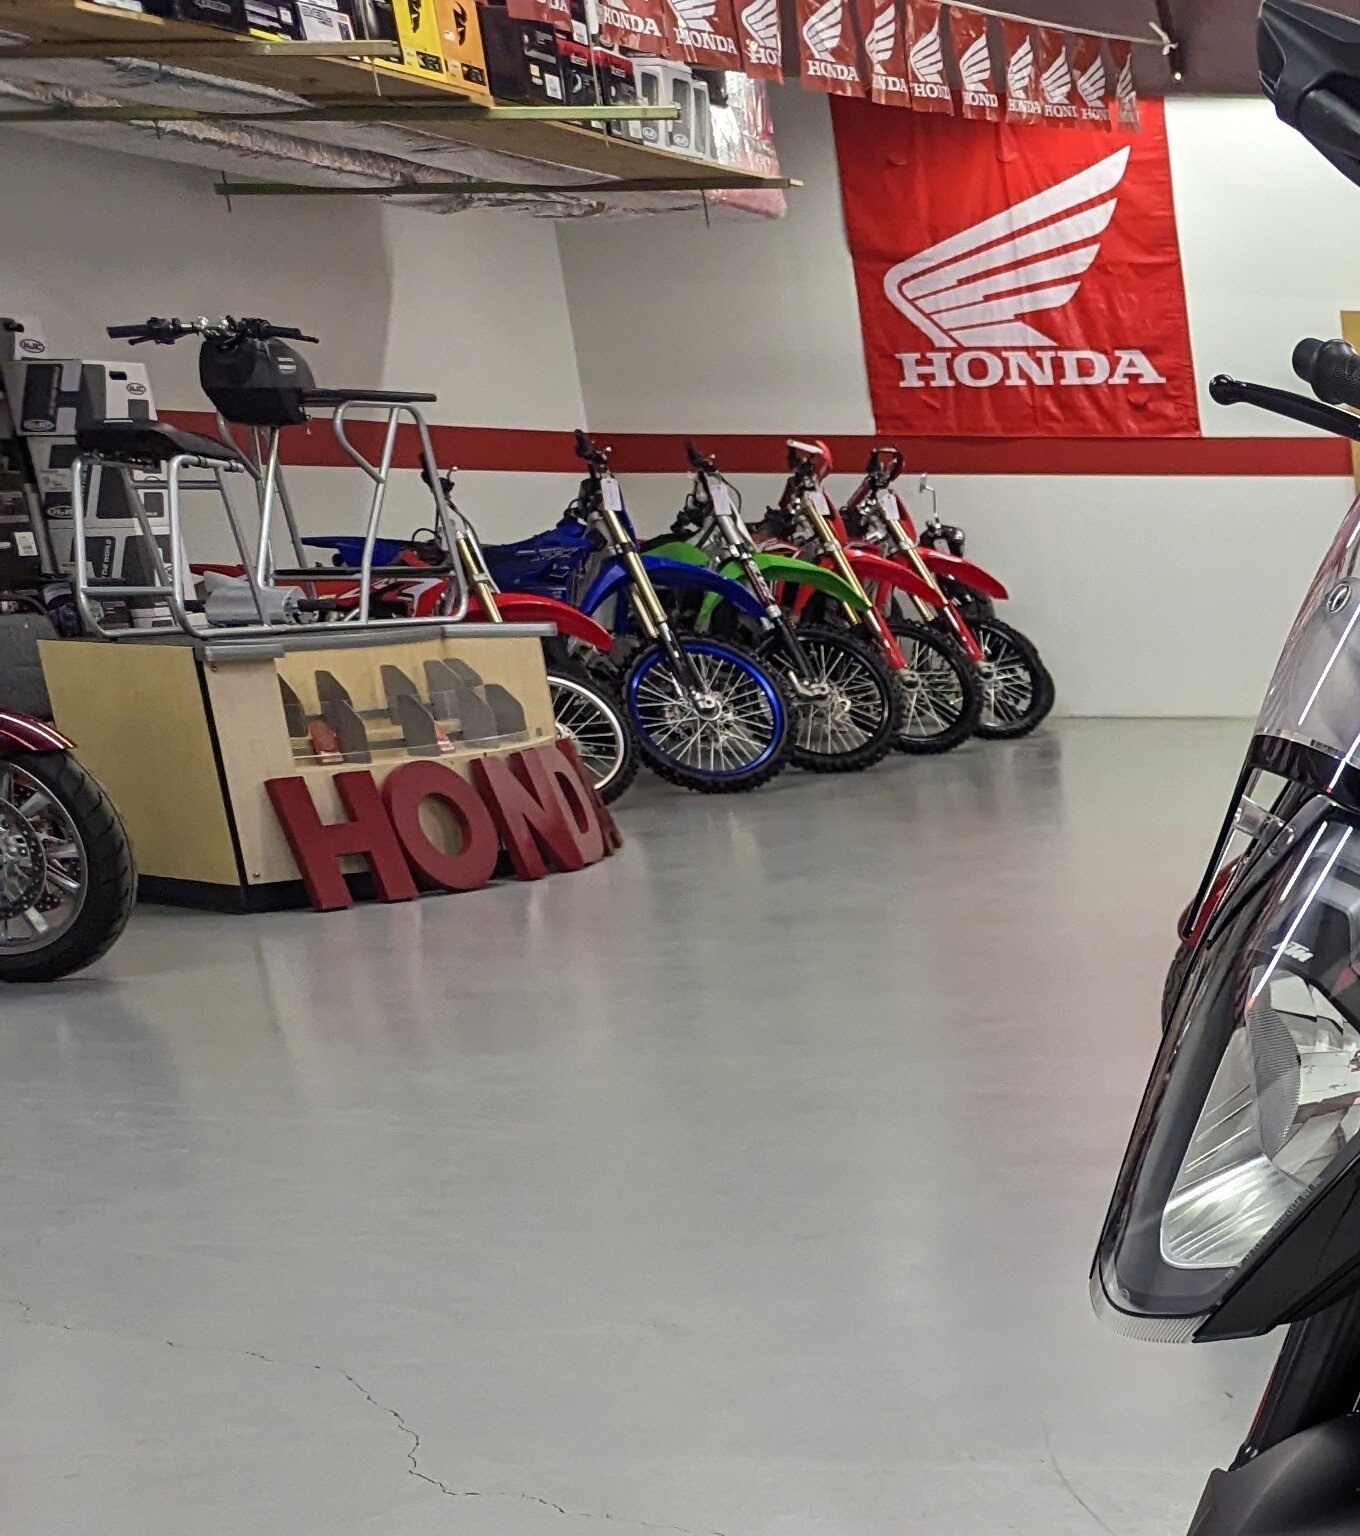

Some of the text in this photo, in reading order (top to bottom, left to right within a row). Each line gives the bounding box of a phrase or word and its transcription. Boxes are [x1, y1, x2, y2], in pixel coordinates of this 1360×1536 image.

[602, 6, 662, 36] HONDA
[673, 27, 738, 55] HONDA
[744, 44, 781, 65] HO
[895, 349, 1167, 388] HONDA
